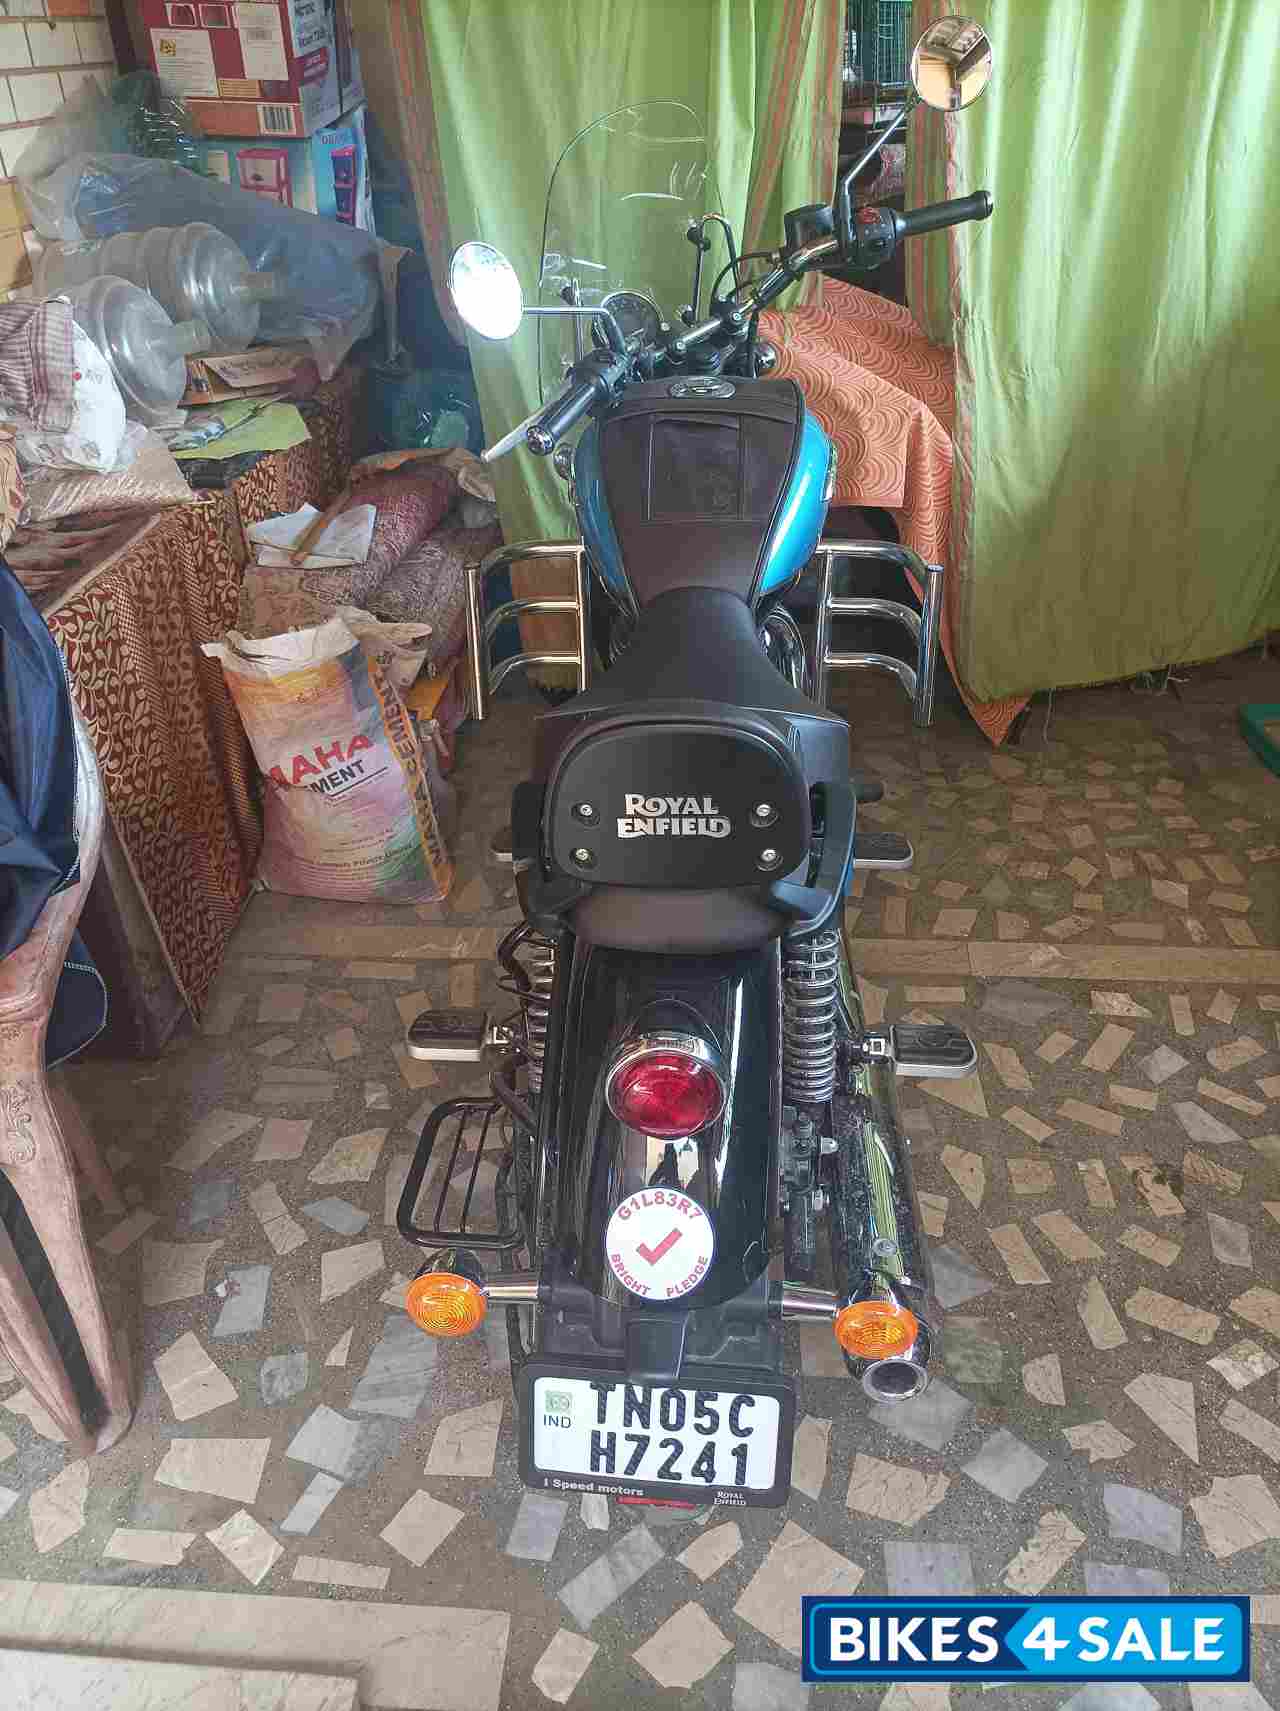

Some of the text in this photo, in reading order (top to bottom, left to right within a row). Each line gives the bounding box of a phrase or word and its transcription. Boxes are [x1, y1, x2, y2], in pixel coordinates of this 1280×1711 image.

[306, 760, 364, 793] MENT
[624, 793, 719, 817] ROYAL
[617, 817, 731, 838] ENFIELD
[617, 1190, 703, 1221] G1L83R7
[611, 1253, 708, 1297] BRIGHT PLEDGE
[543, 1414, 572, 1429] IND
[589, 1383, 757, 1439] TN05C
[589, 1430, 749, 1486] H7241
[552, 1478, 594, 1492] Speed
[598, 1484, 645, 1497] motors
